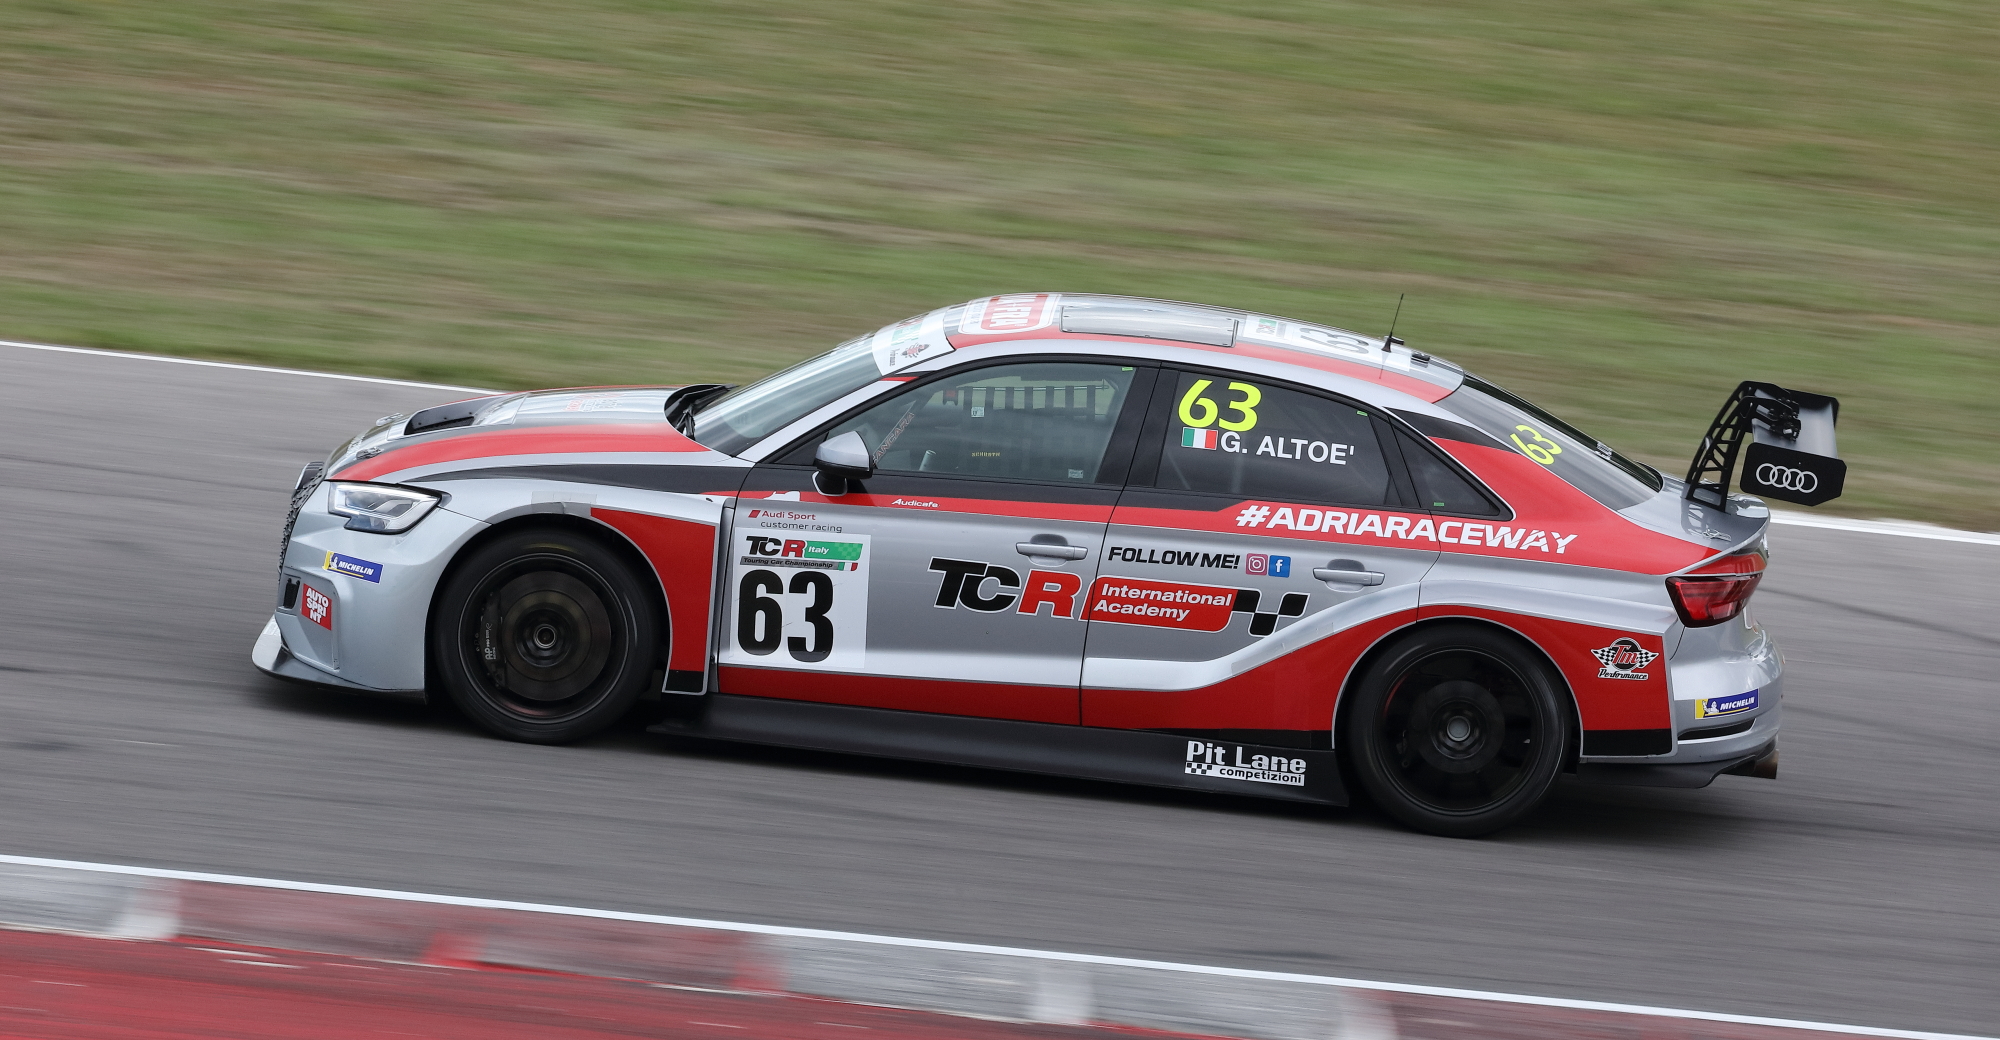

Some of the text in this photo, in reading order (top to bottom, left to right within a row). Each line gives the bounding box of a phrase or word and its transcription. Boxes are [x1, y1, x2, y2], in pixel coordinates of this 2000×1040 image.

[1177, 379, 1262, 432] 63
[1220, 431, 1355, 466] G. ALTOE'
[1509, 424, 1563, 465] 63
[891, 498, 940, 508] Audicafe
[761, 510, 816, 521] Audi Sport
[760, 521, 843, 534] customer racing
[1235, 504, 1579, 554] #ADRIARACEWAY
[745, 535, 830, 558] TCR Italy
[338, 560, 374, 576] MICHELIN
[743, 557, 769, 566] Touring
[784, 560, 834, 569] Championship
[1107, 546, 1241, 570] FOLLOW ME!
[306, 587, 329, 608] AUTO
[927, 556, 1083, 620] TCR
[1100, 583, 1233, 608] International
[306, 597, 327, 617] SPRI
[309, 609, 322, 624] NT
[737, 569, 834, 663] 63
[1094, 600, 1191, 622] Academy
[1611, 645, 1639, 665] Tm
[1599, 668, 1648, 680] Performance
[1719, 696, 1755, 711] MICHELIN
[1186, 740, 1307, 774] Pit Lane
[1219, 768, 1302, 784] competizioni
